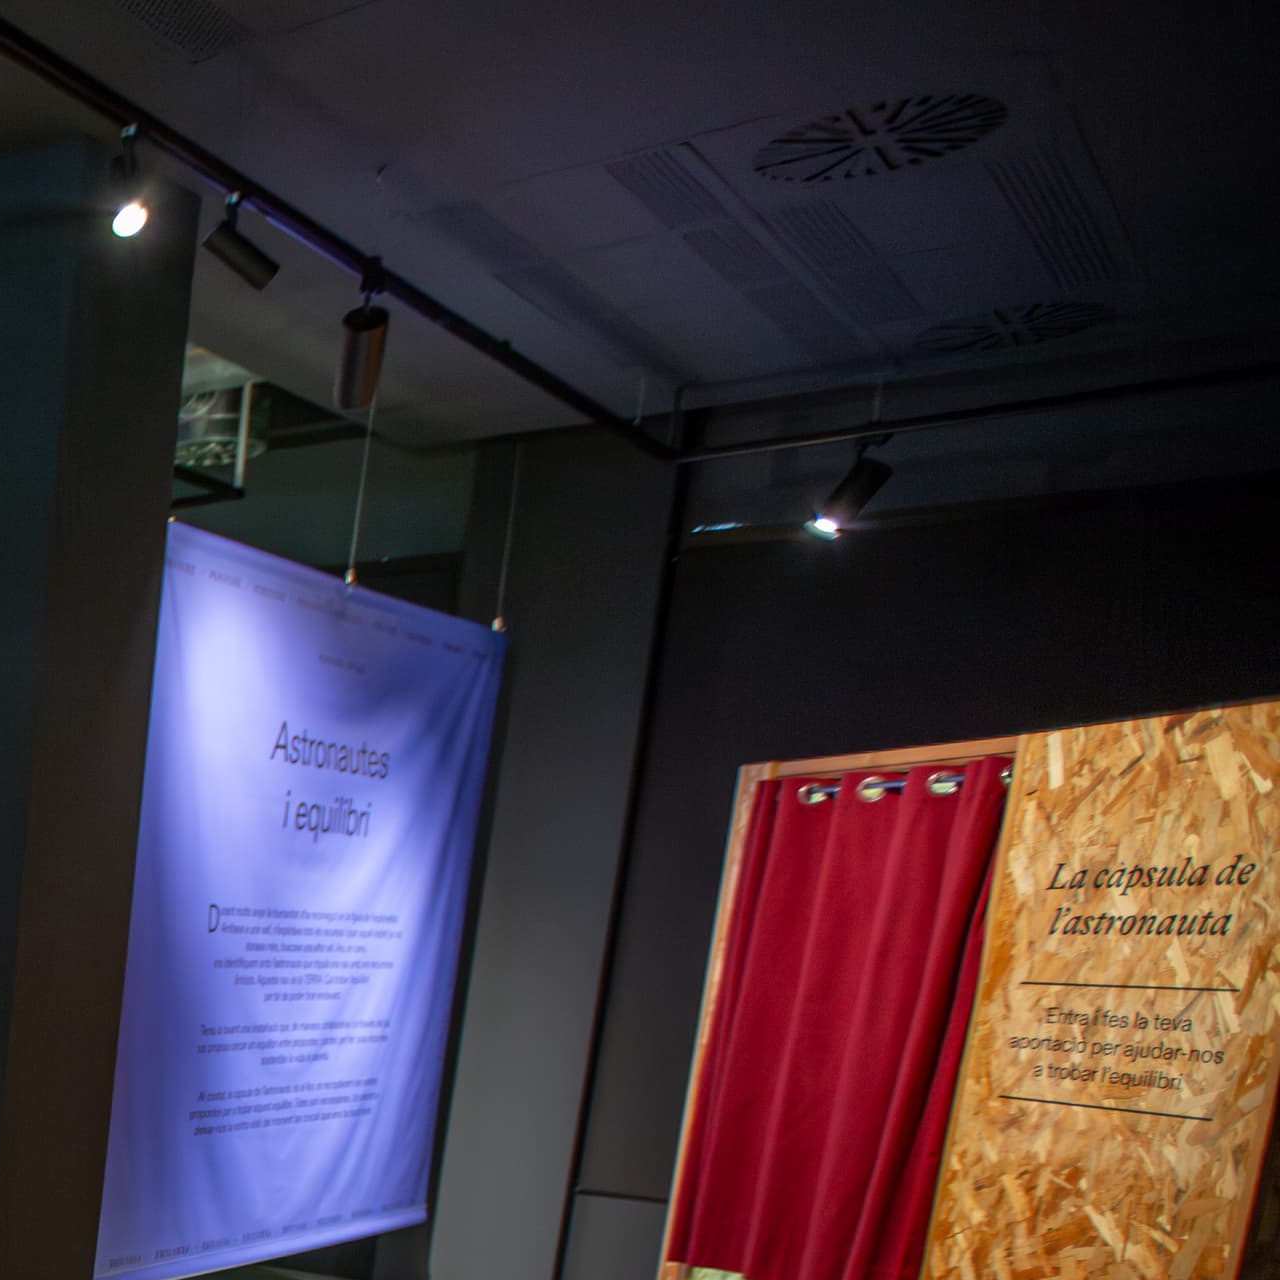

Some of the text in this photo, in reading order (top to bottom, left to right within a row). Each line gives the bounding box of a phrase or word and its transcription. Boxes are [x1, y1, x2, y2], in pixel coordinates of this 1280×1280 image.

[270, 720, 390, 780] Astronautes
[282, 789, 372, 844] i equilibri
[1046, 854, 1256, 896] La càpsula de
[1046, 1006, 1089, 1026] Entra
[1103, 1009, 1129, 1029] fes
[1134, 1011, 1149, 1030] la
[1154, 1014, 1193, 1032] teva
[1091, 1041, 1121, 1058] per
[1124, 1040, 1225, 1065] ajudar-nos
[1033, 1064, 1044, 1078] a
[1047, 1064, 1098, 1082] trobar
